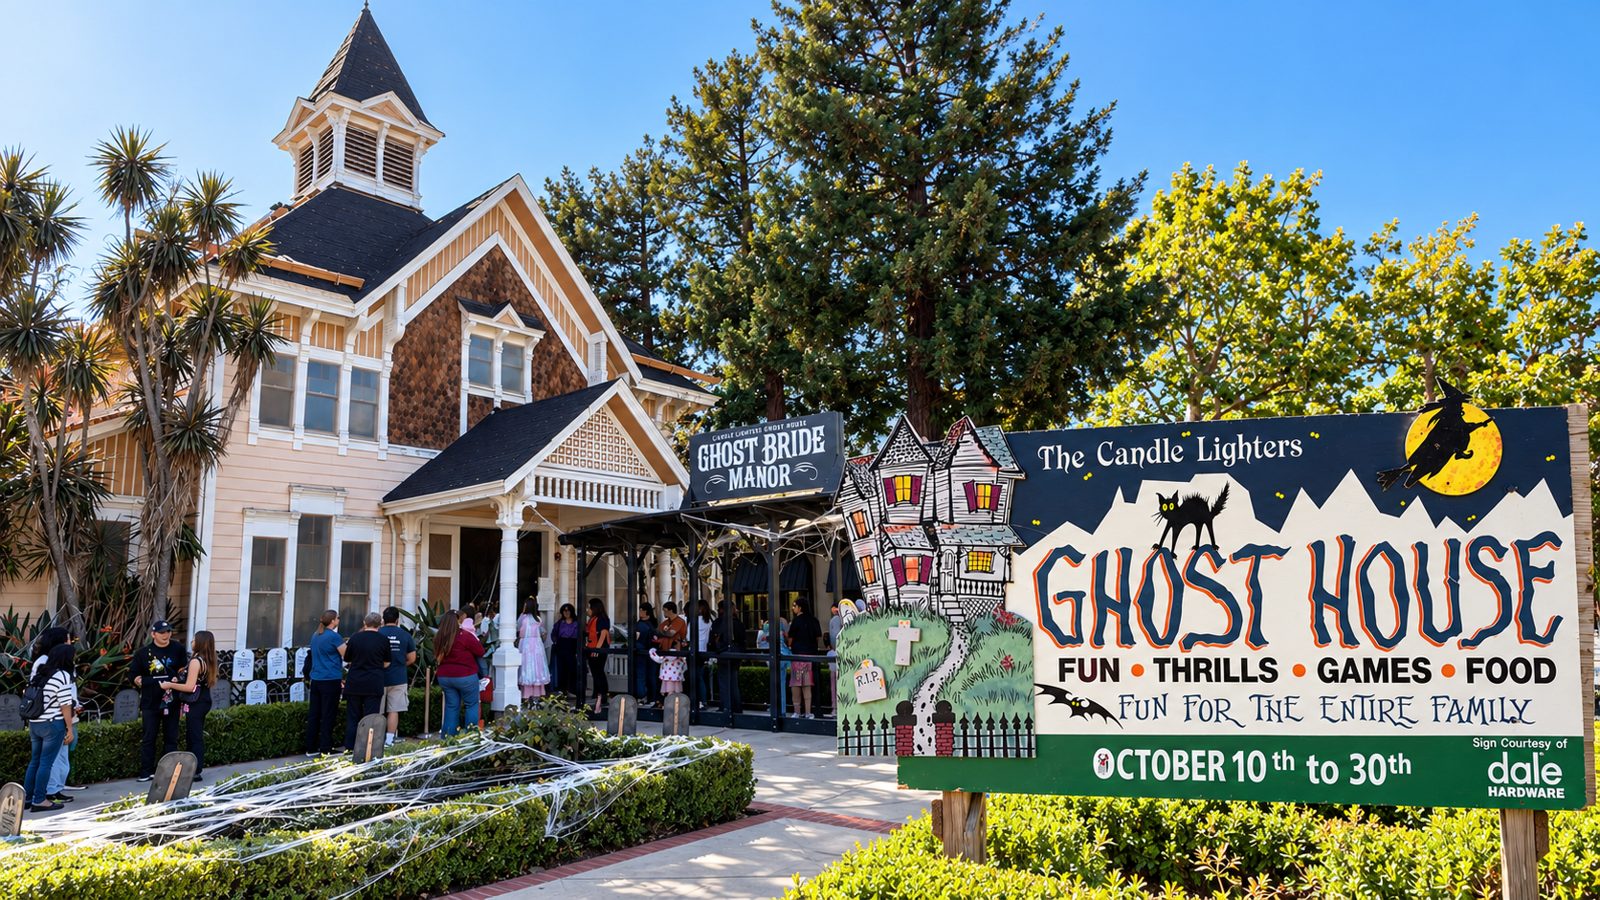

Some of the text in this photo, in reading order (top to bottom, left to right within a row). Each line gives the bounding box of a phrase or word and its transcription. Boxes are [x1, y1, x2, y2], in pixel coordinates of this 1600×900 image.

[698, 425, 825, 472] GHOST BRIDE
[1037, 433, 1303, 474] The Candle Lighters
[728, 464, 792, 491] MANOR
[1032, 530, 1564, 653] GHOST HOUSE
[1058, 657, 1557, 684] FUN THRILLS GAMES FOOD
[1118, 692, 1536, 729] FUN FOR THE ENTIRE FAMILY
[1472, 737, 1568, 751] Sign Courtesy of
[1092, 747, 1226, 782] OCTOBER
[1305, 754, 1340, 785] to
[1487, 751, 1563, 785] dale
[1487, 786, 1565, 799] HARDWARE
